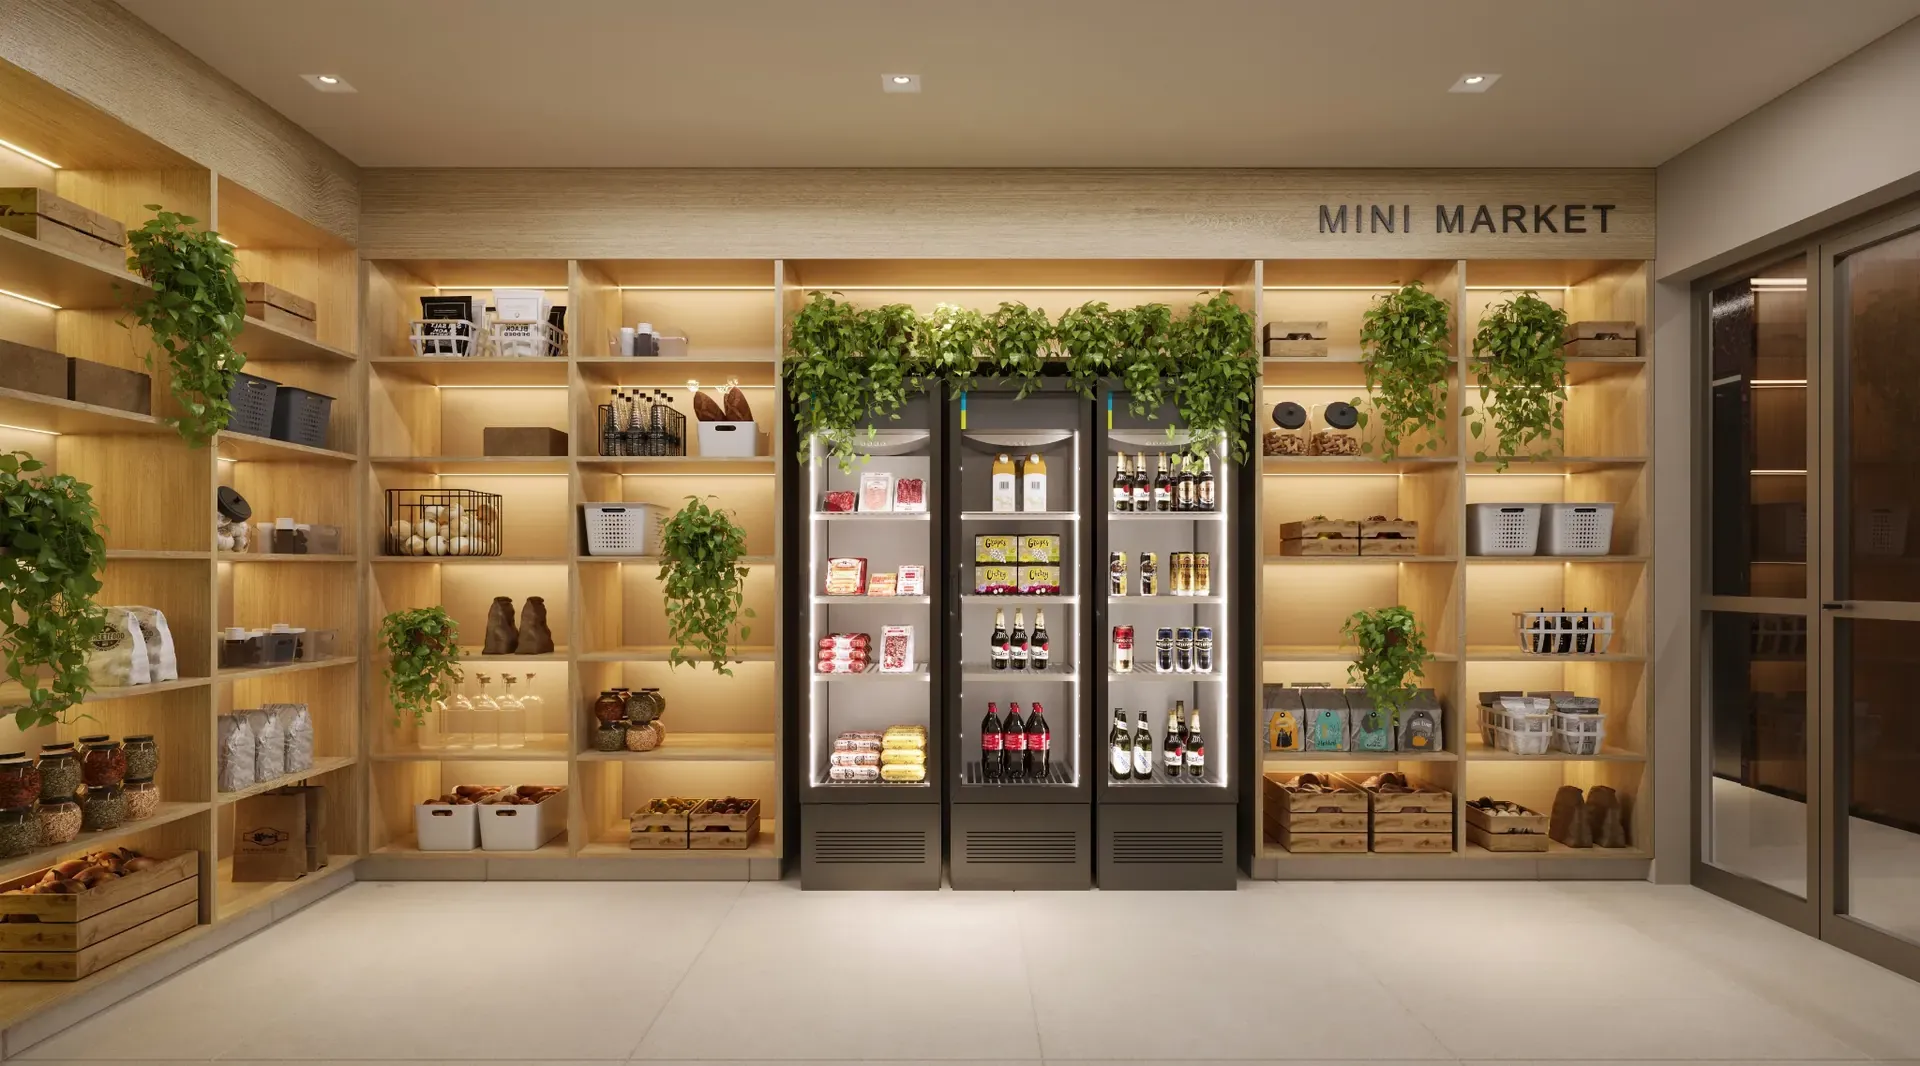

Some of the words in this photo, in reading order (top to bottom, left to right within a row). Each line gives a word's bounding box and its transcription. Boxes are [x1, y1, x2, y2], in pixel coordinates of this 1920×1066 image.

[1319, 204, 1410, 234] MINI
[1436, 204, 1616, 234] MARKET
[985, 537, 1007, 548] Grapes
[1027, 537, 1049, 548] Grapes
